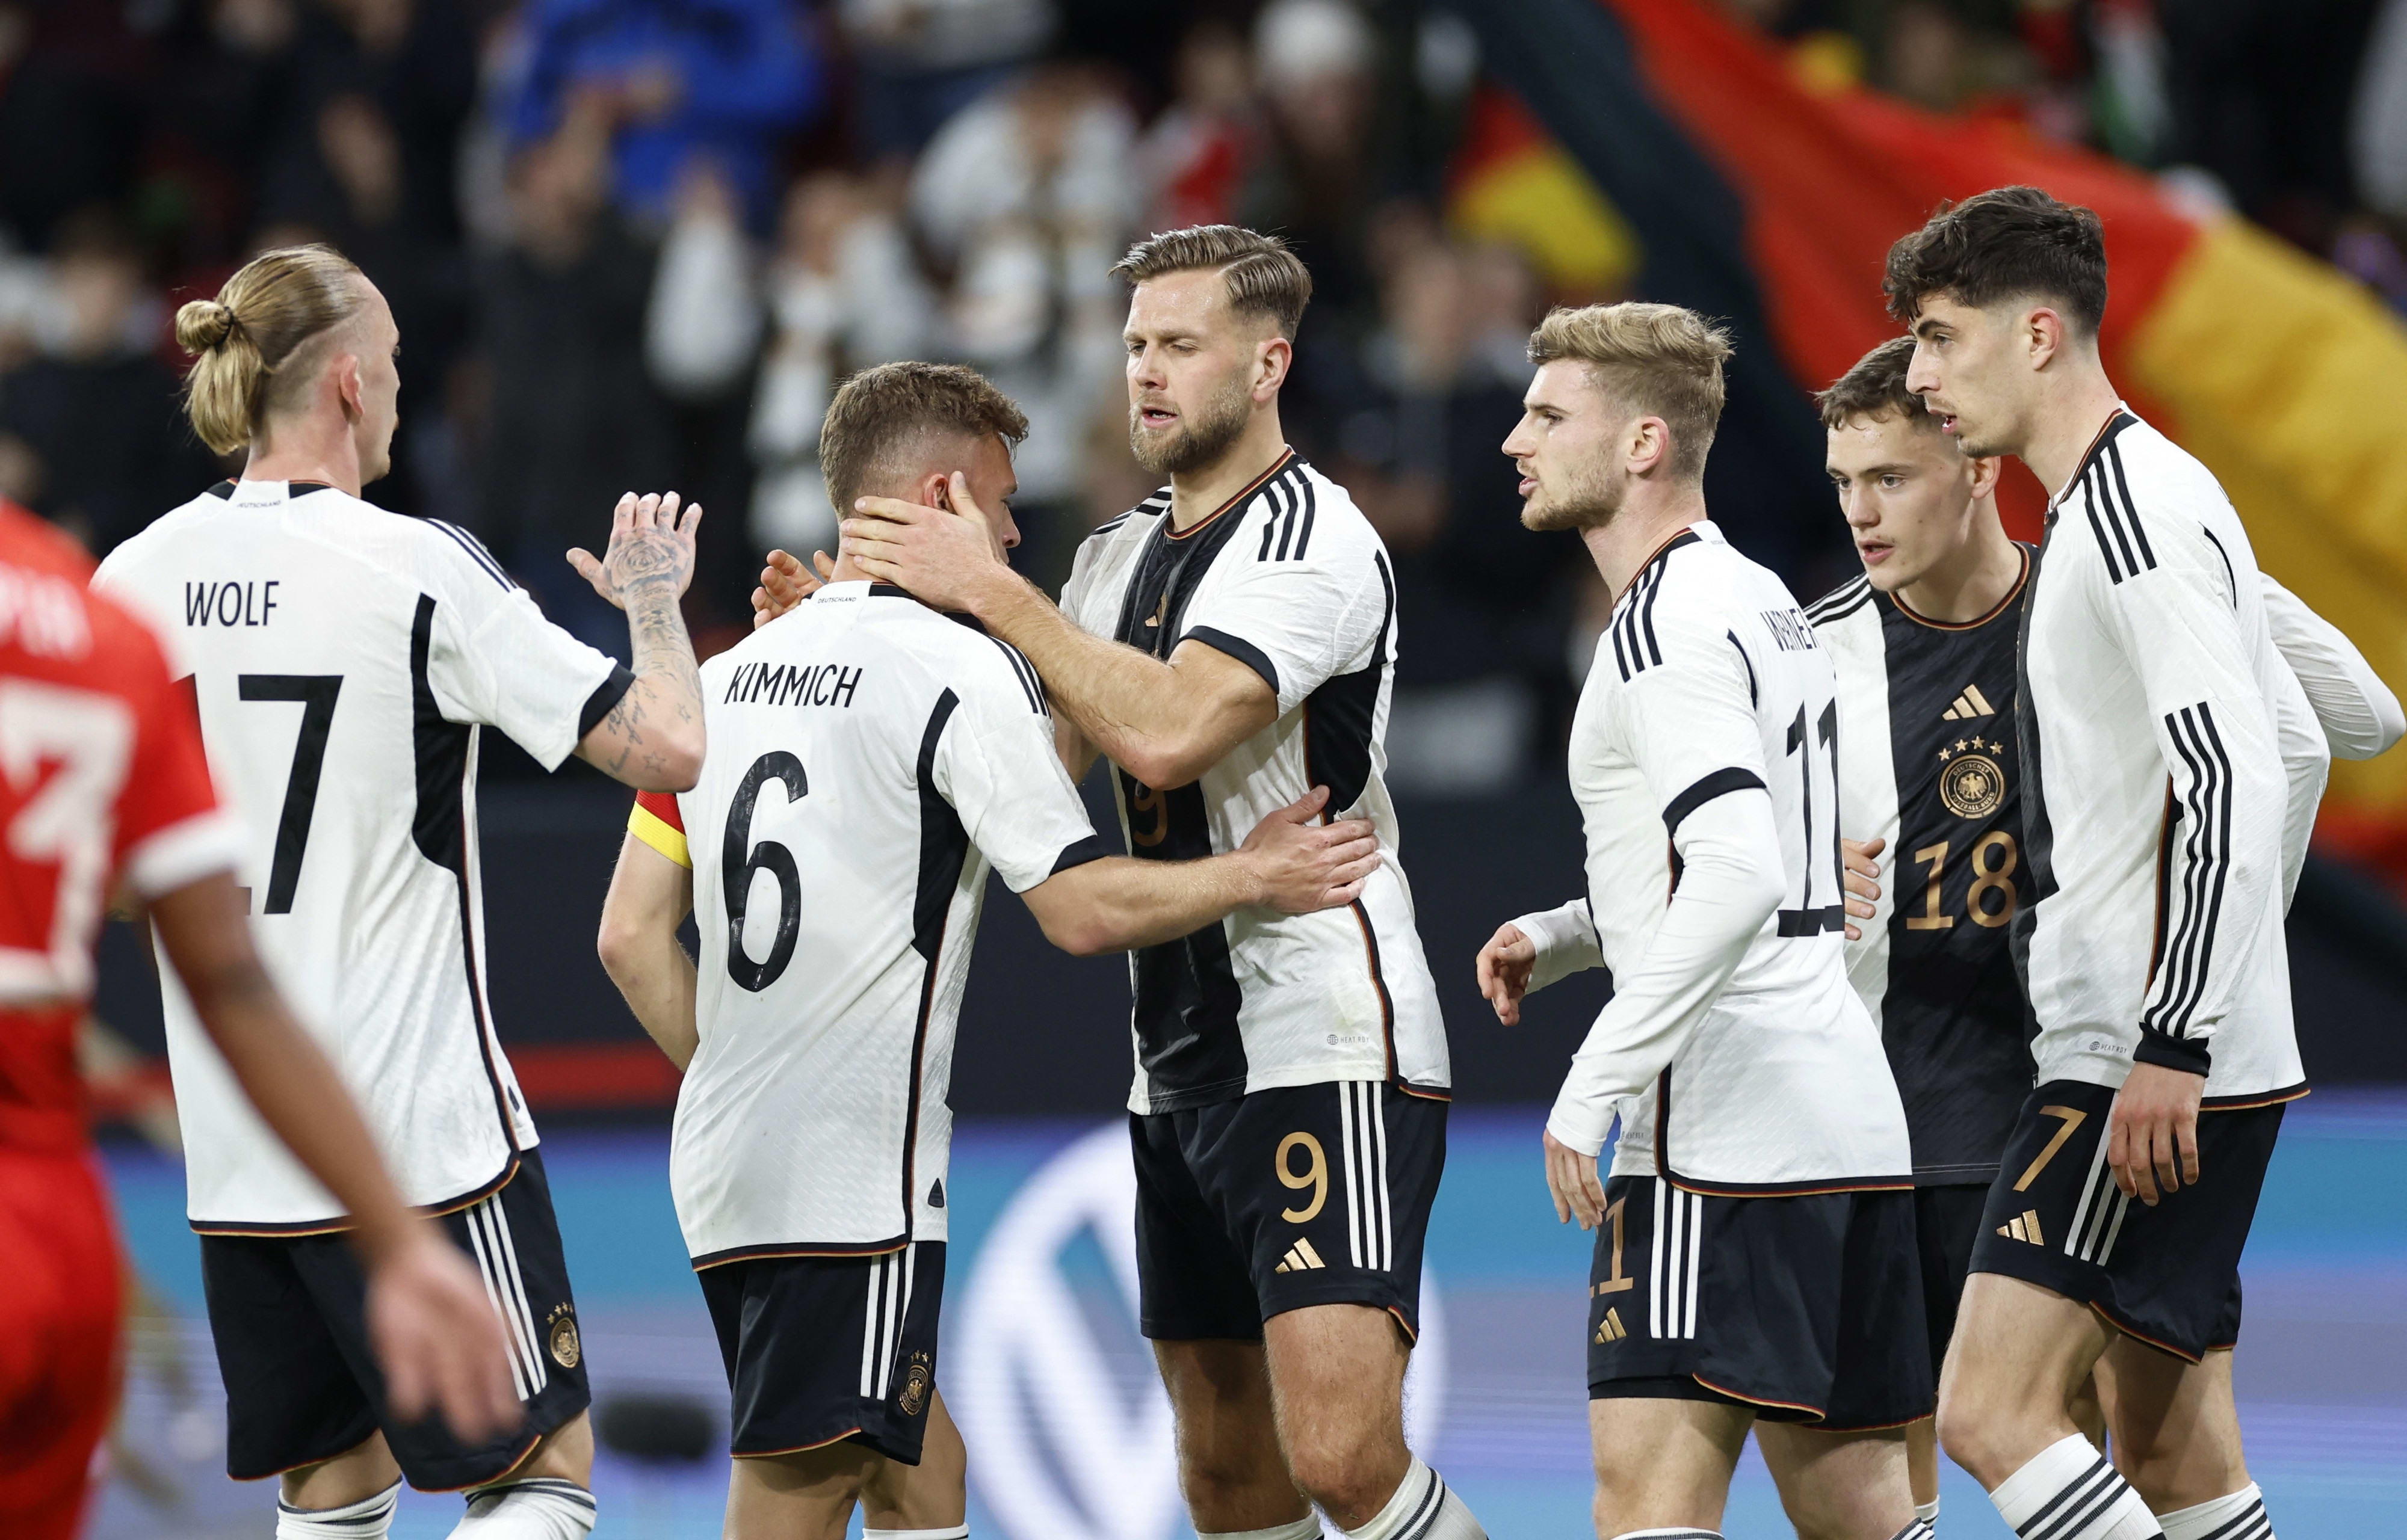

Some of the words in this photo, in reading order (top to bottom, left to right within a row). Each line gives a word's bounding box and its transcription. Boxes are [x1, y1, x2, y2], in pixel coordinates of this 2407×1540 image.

[185, 581, 280, 627] WOLF
[723, 662, 863, 708] KIMMICH
[190, 673, 344, 915] 7
[1132, 778, 1168, 847] 9
[1953, 763, 1990, 776] DEUTSCHER
[1777, 696, 1845, 937] 11
[722, 751, 808, 992] 6
[1906, 830, 2017, 930] 18
[1275, 1131, 1328, 1224] 9
[2012, 1105, 2088, 1192] 7
[1589, 1195, 1634, 1299] 1
